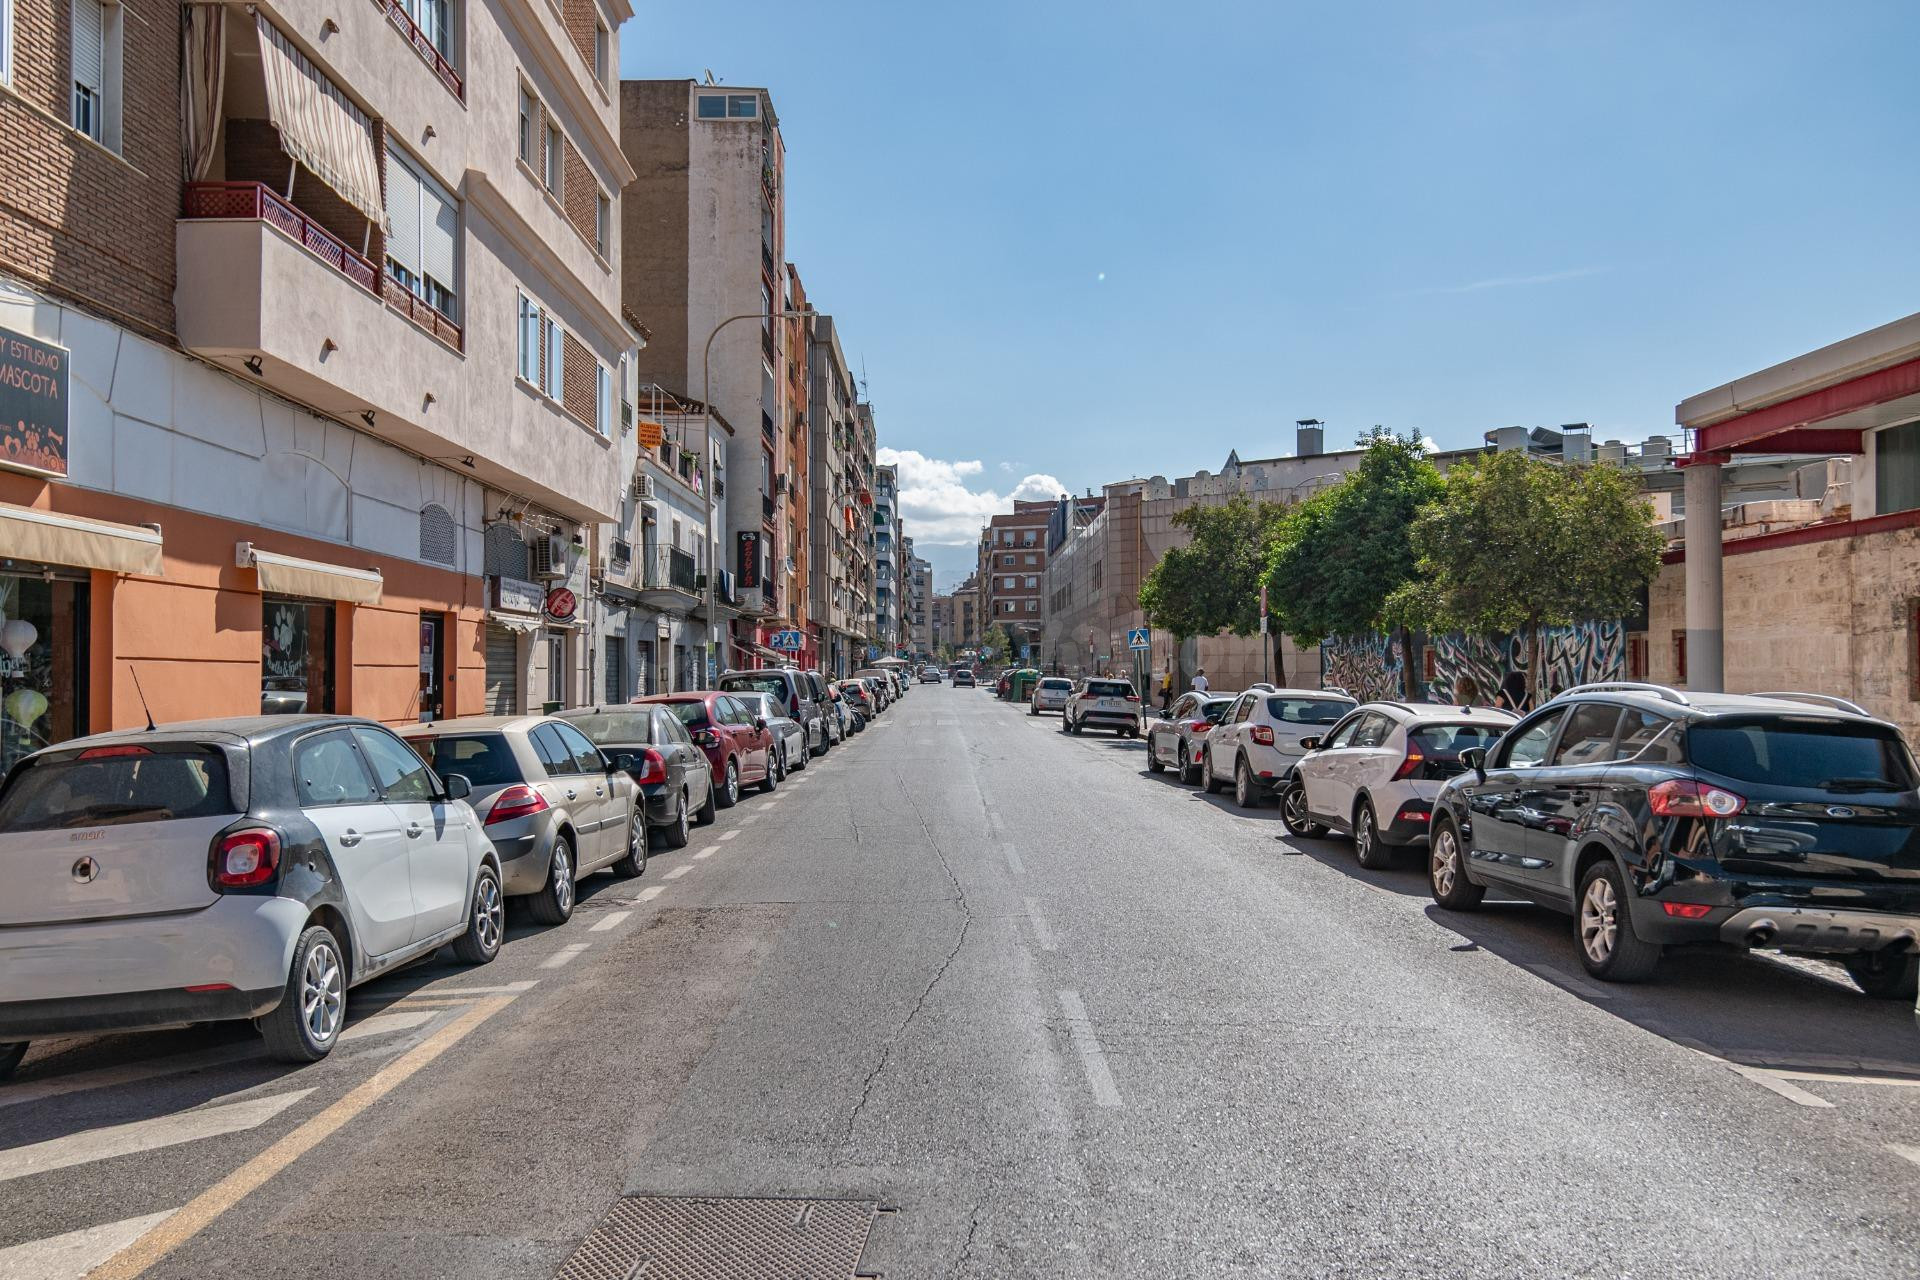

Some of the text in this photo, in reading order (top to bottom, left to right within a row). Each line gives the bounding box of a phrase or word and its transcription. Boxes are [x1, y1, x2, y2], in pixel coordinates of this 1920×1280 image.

[0, 336, 59, 371] Y ESTILISMO
[772, 635, 780, 646] P
[71, 830, 105, 841] smart
